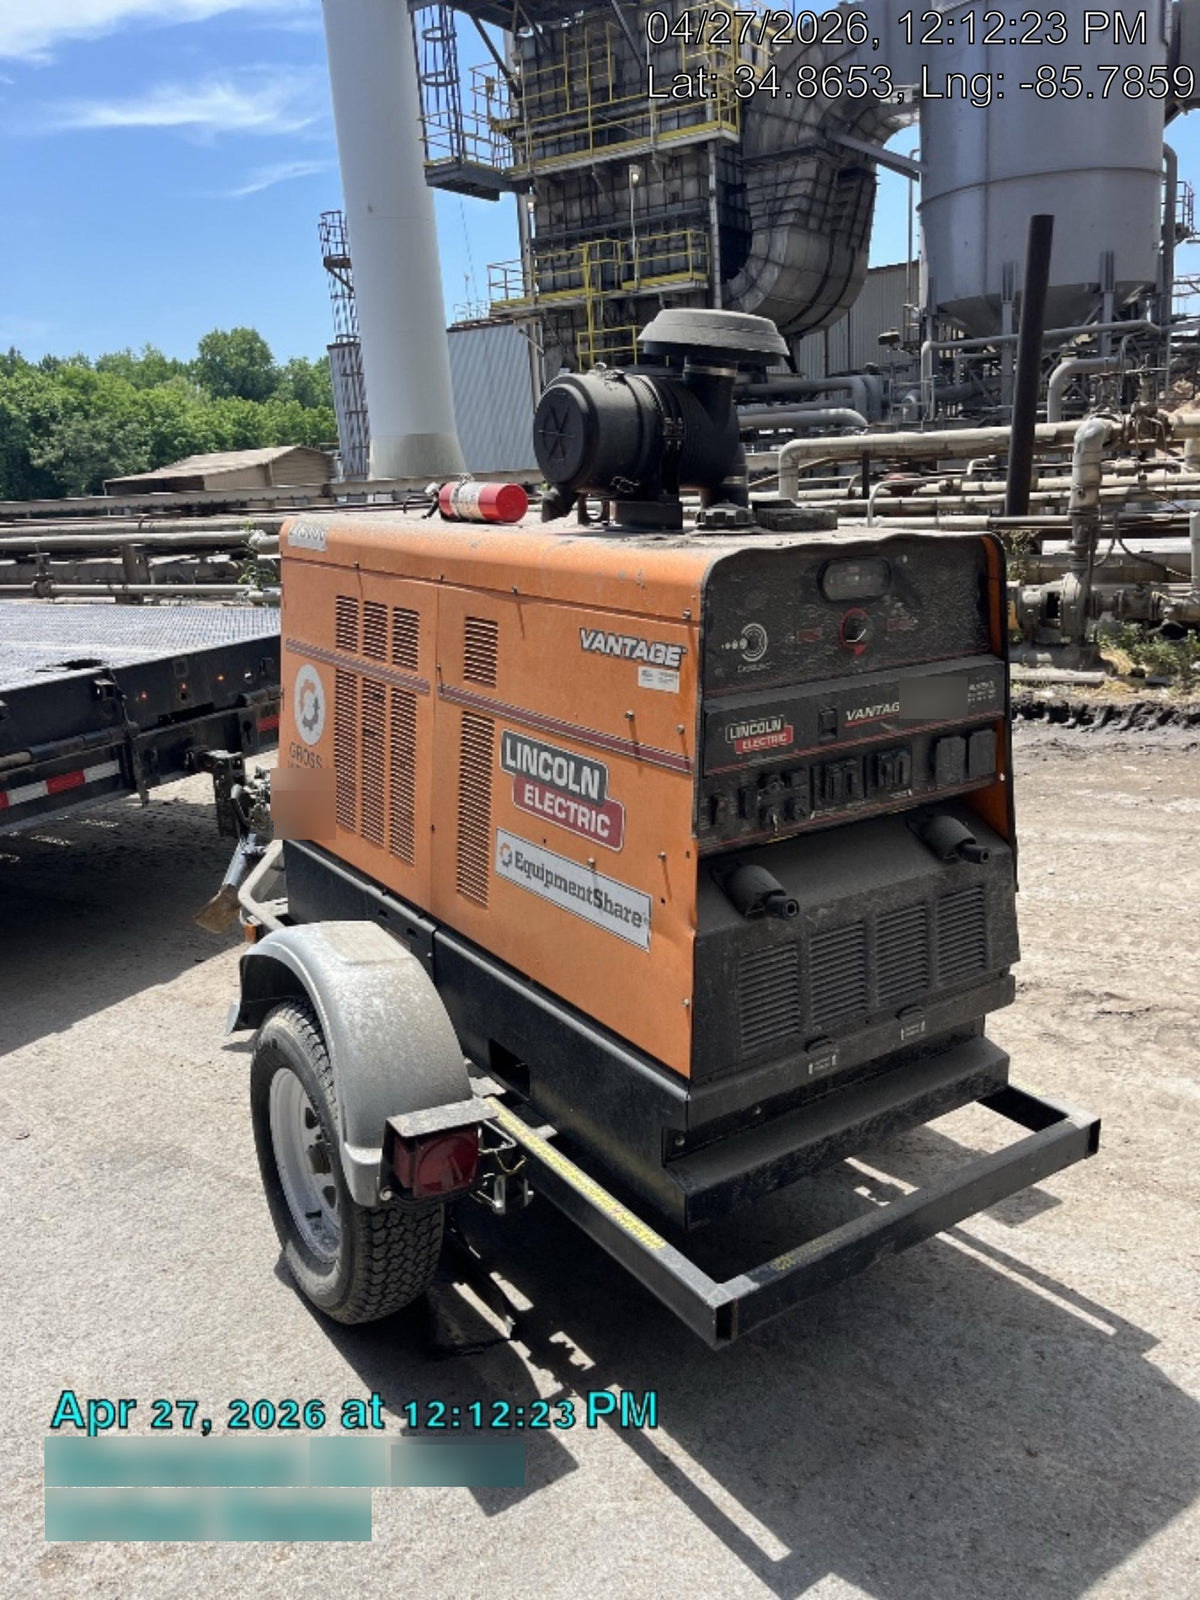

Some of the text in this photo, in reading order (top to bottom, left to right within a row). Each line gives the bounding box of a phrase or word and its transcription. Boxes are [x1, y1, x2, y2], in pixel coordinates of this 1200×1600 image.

[580, 627, 681, 669] VANTAGE
[730, 719, 782, 740] LINCOLN
[845, 701, 900, 721] VANTAG
[742, 733, 787, 750] ELECTRIC
[505, 737, 600, 801] LINCOLN
[524, 783, 611, 839] ELECTRIC
[513, 849, 643, 929] EquipmentShare
